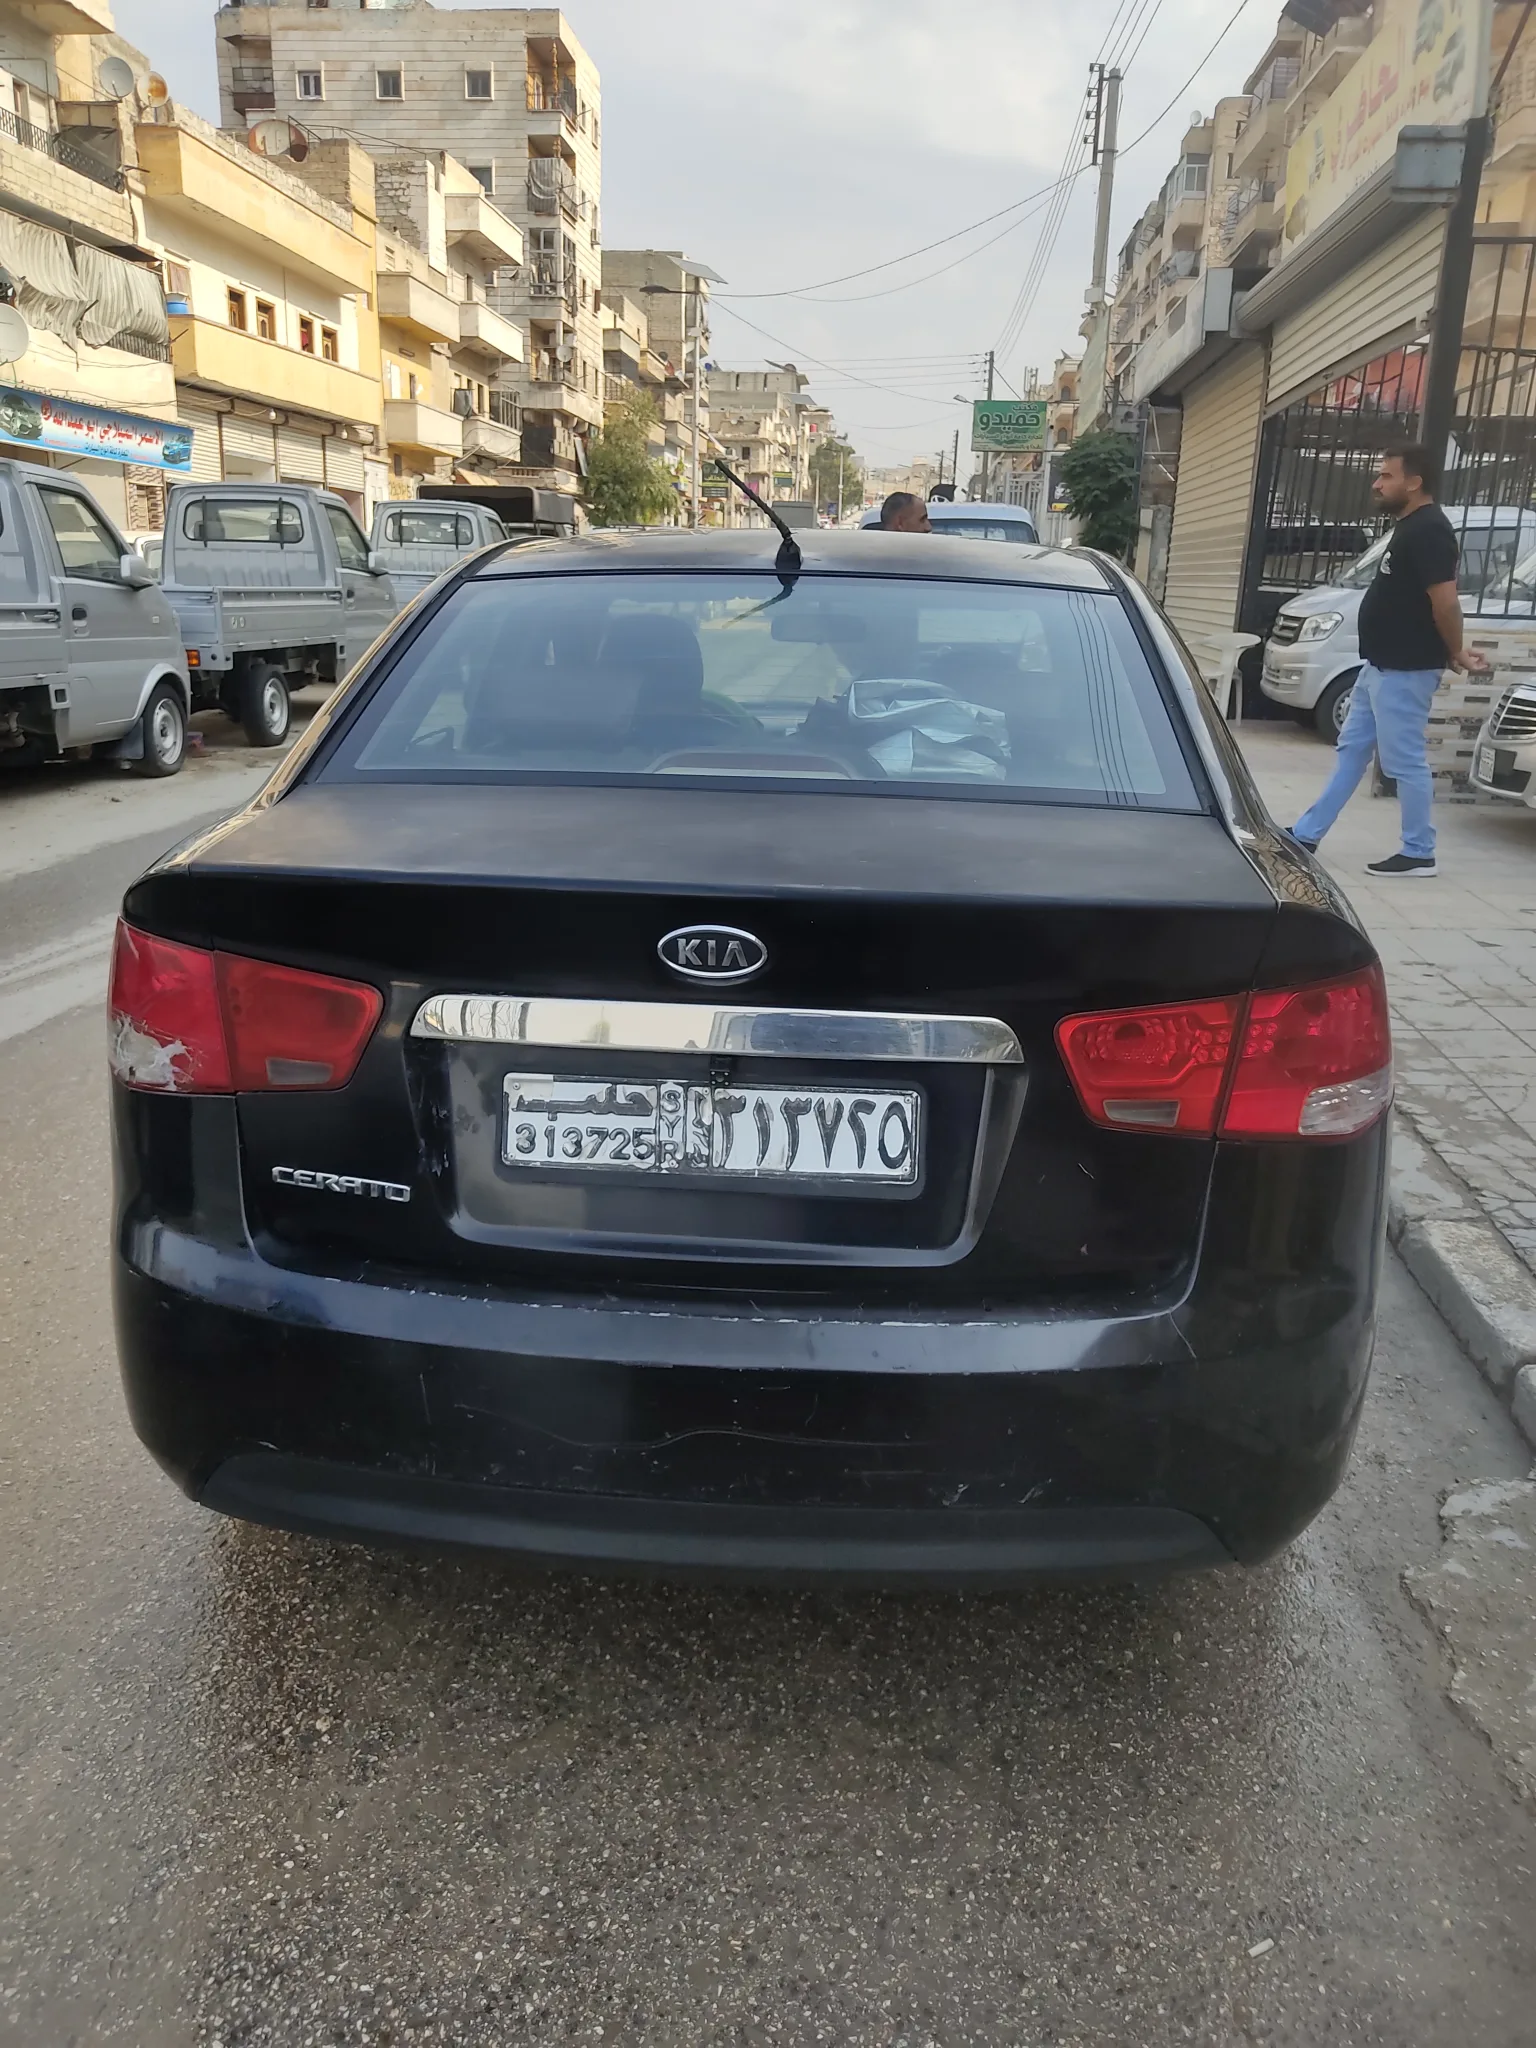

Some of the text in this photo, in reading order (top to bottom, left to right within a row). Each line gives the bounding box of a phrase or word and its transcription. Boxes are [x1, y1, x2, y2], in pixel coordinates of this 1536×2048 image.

[978, 412, 1041, 432] حميدو
[1012, 403, 1038, 413] مكتب
[676, 938, 748, 967] KIA
[512, 1083, 654, 1121] حلب
[515, 1122, 655, 1160] 313725
[661, 1089, 682, 1164] SYR
[713, 1095, 912, 1169] ٣١٣٧٢٥
[271, 1166, 411, 1203] CERATO
